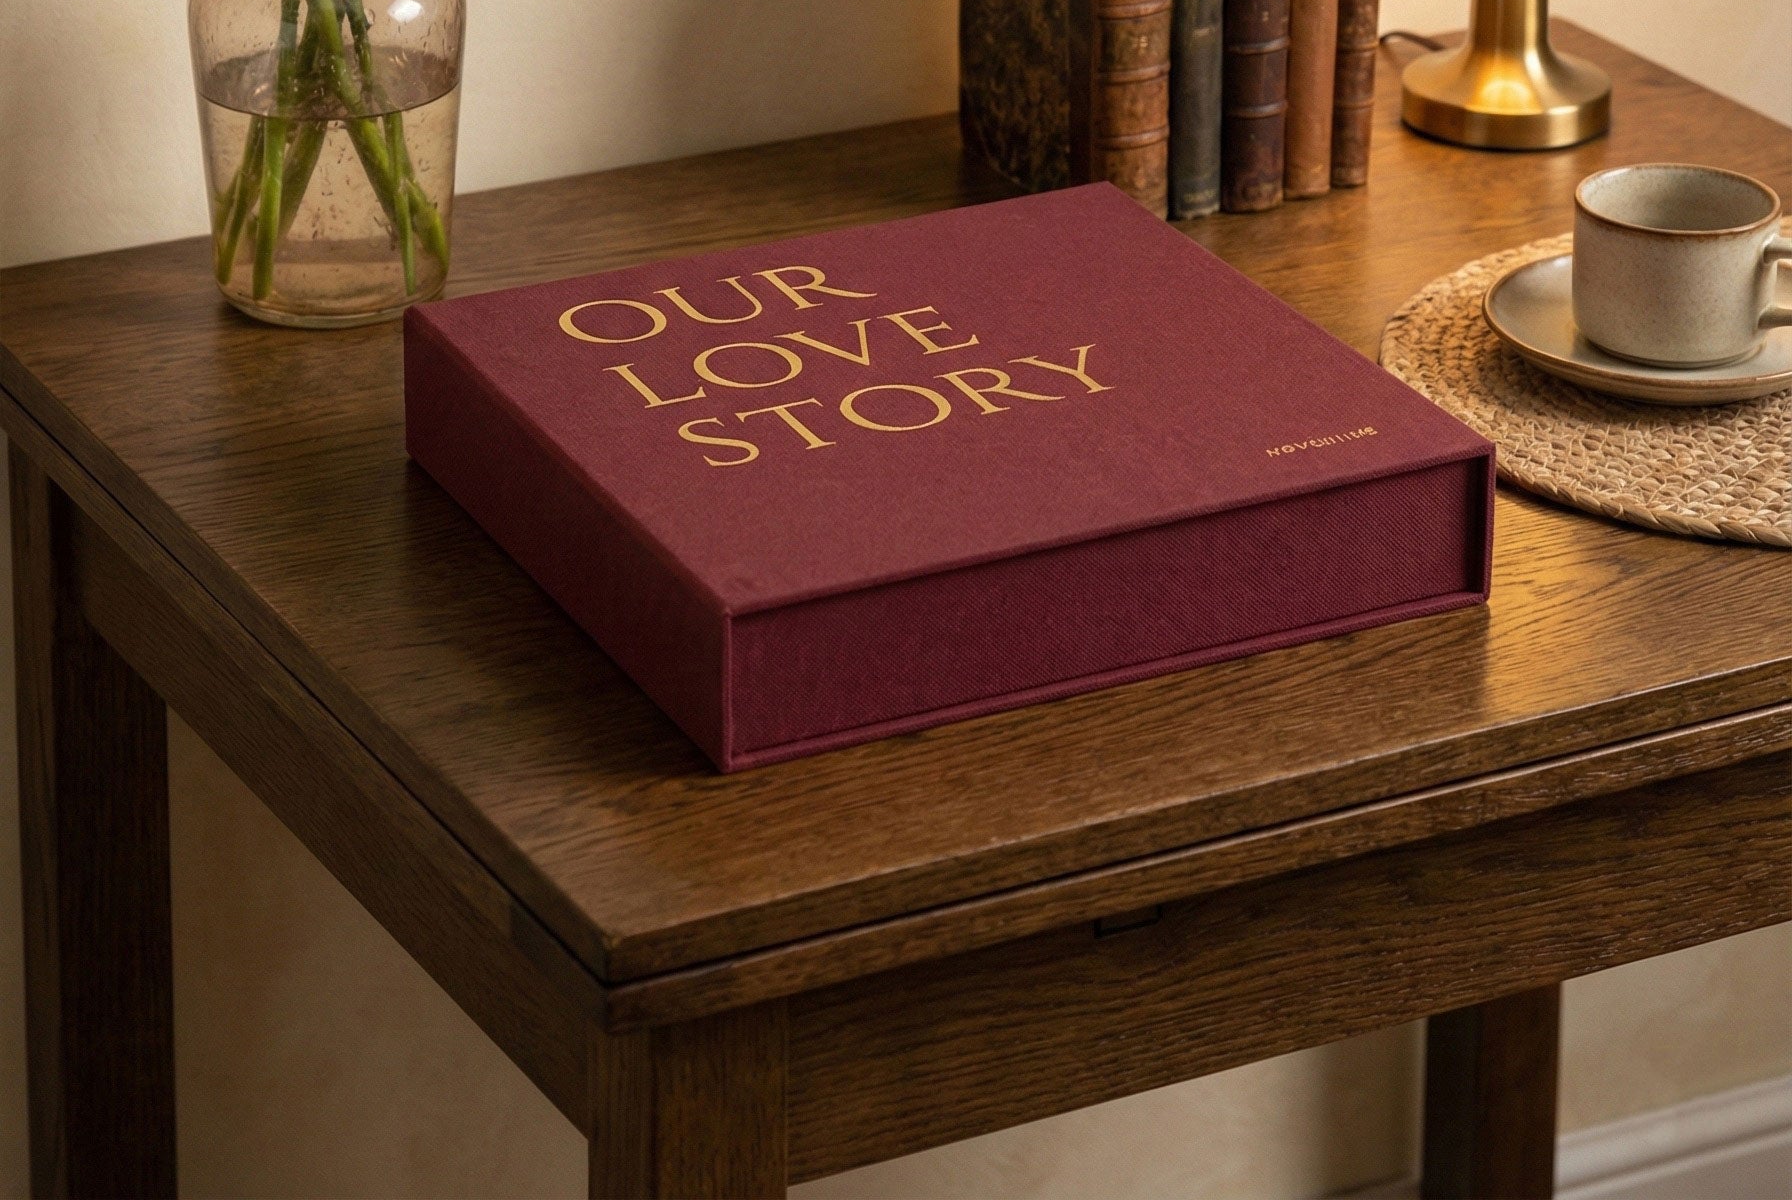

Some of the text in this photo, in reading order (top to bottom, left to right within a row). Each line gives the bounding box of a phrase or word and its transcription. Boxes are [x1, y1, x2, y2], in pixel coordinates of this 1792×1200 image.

[559, 266, 877, 344] OUR
[603, 306, 980, 409] LOVE
[678, 343, 1114, 467] STORY
